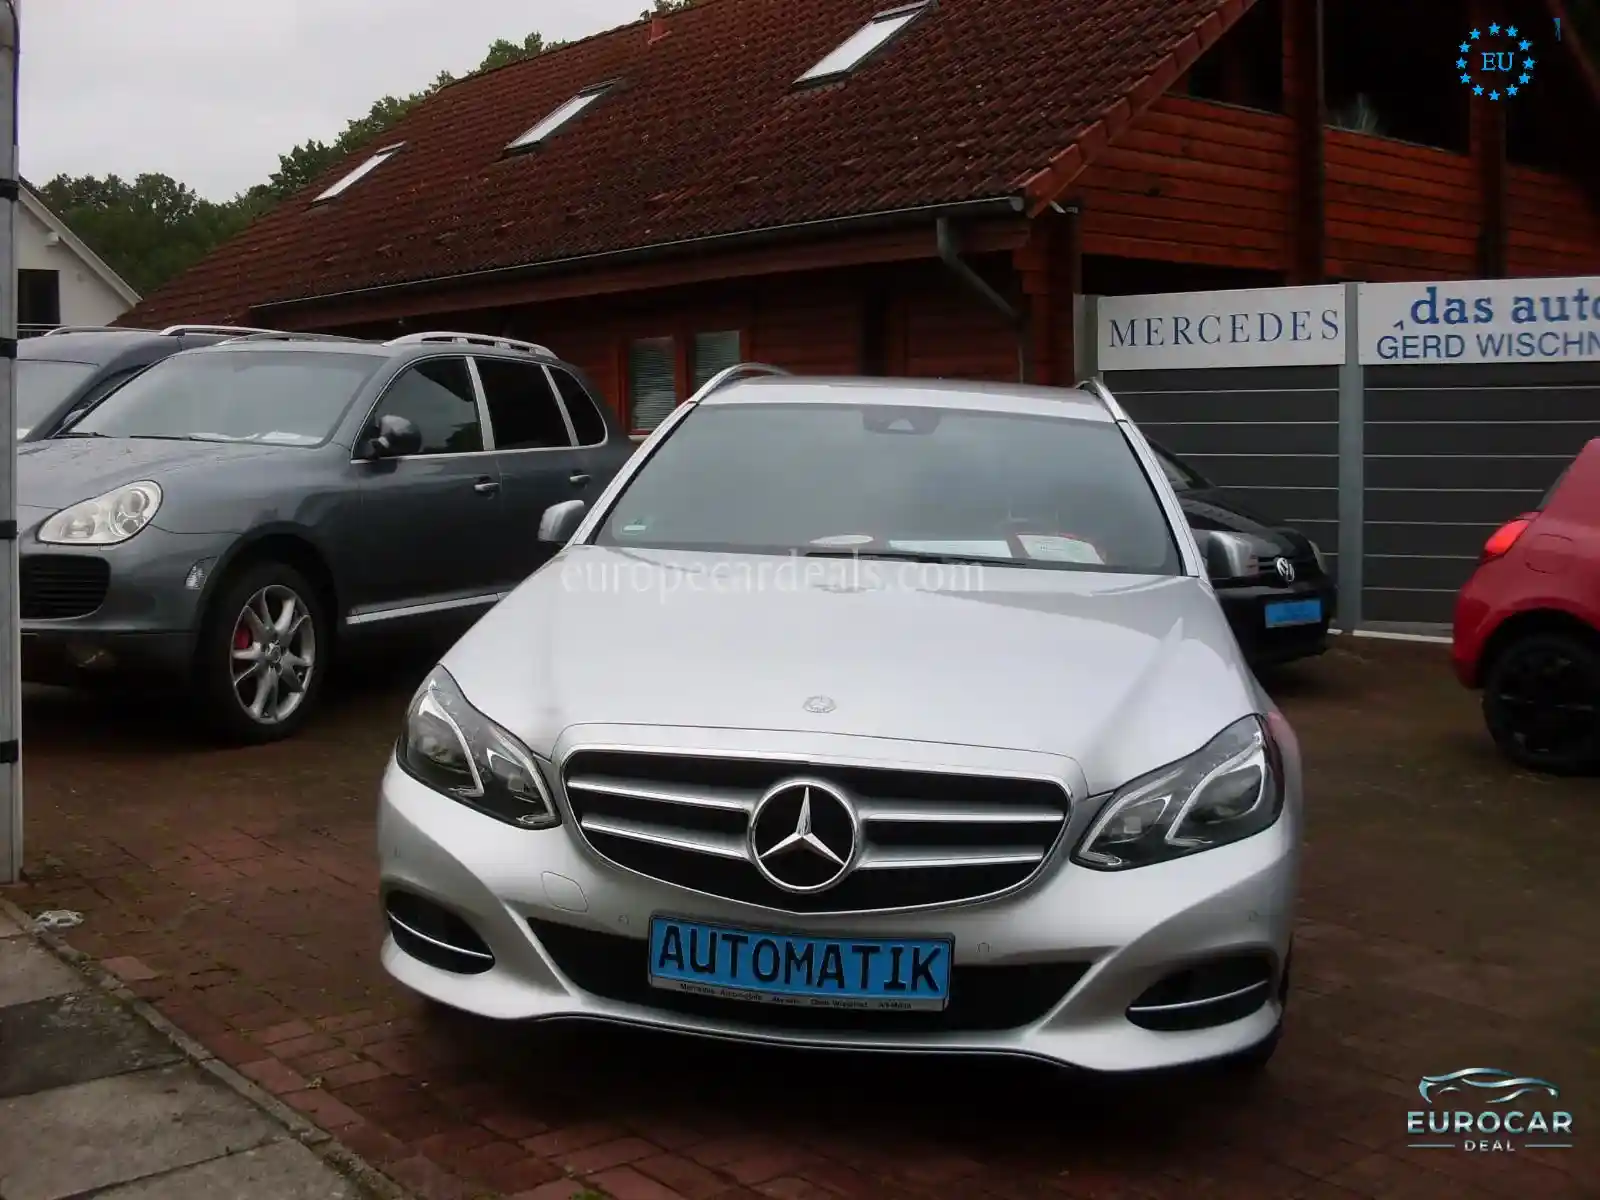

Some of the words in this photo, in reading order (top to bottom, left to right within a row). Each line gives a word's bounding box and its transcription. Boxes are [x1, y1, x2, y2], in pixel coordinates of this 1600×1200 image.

[1410, 286, 1494, 325] das
[1109, 308, 1340, 348] MERCEDES
[1376, 333, 1465, 360] GERD
[658, 925, 942, 992] AUTOMATIK
